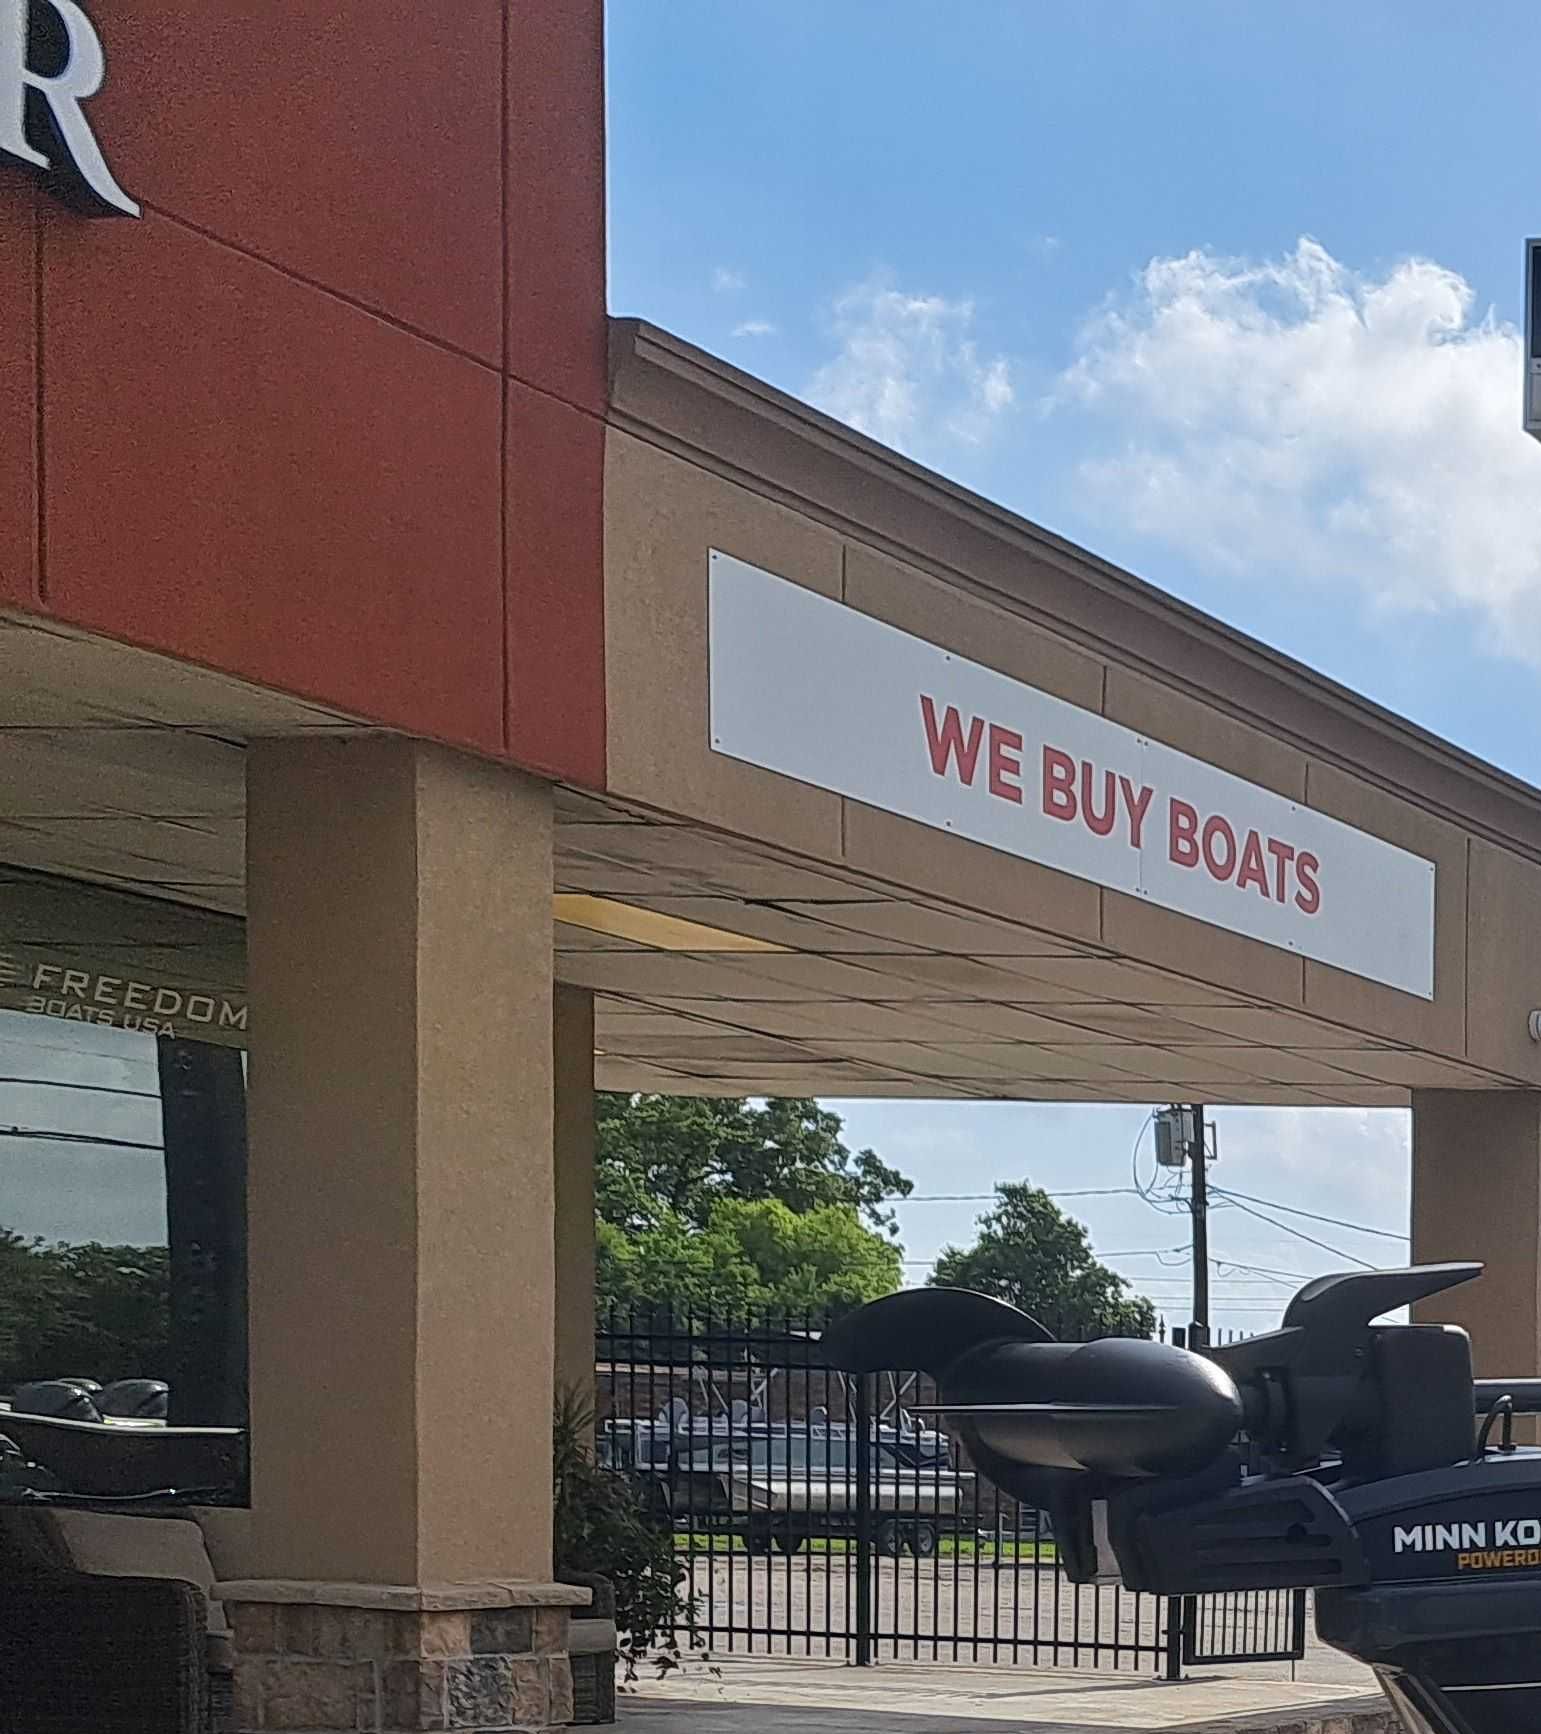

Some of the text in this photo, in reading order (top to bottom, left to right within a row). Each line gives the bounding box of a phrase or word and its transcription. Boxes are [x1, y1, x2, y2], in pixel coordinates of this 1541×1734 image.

[918, 693, 1322, 915] WE BUY BOATS
[31, 962, 248, 1030] FREEDOM
[123, 1013, 176, 1039] USA
[1393, 1521, 1487, 1553] MINN
